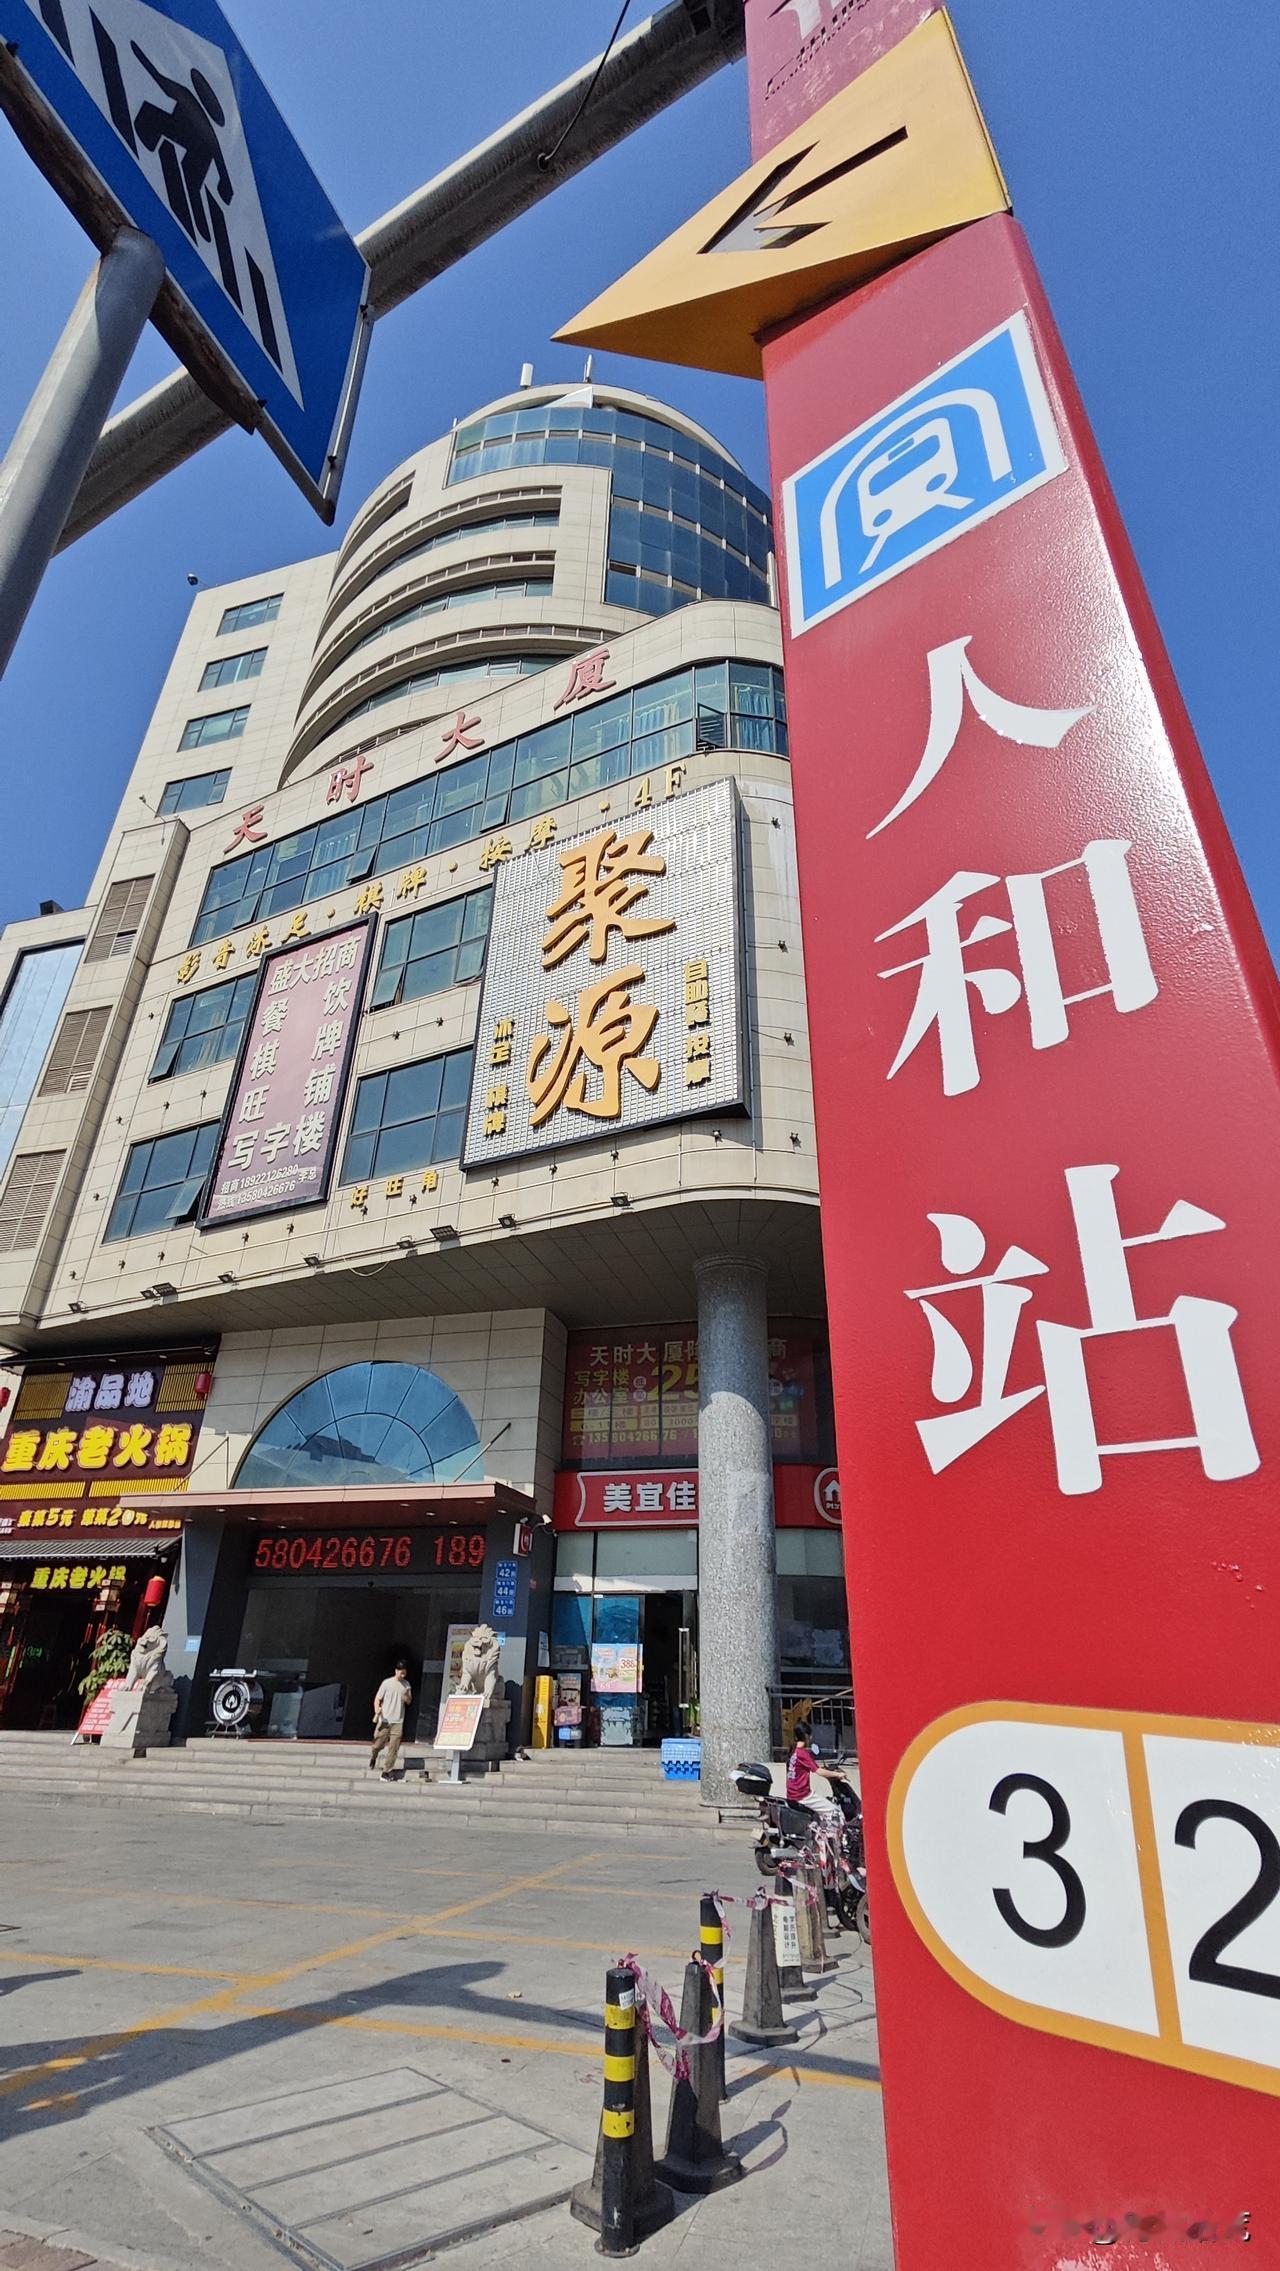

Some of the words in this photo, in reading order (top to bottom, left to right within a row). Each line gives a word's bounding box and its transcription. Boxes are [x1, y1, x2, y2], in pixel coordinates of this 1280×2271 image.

[224, 648, 617, 854] 天时大厦
[268, 934, 362, 997] 盛大招商
[527, 827, 678, 1129] 聚源
[260, 978, 353, 1038] 餐饮
[250, 1019, 344, 1082] 棋牌
[866, 635, 1261, 1496] 人和站
[239, 1065, 336, 1124] 旺铺
[227, 1111, 326, 1172] 写字楼
[352, 1169, 439, 1208] 好旺角
[575, 1368, 630, 1388] 写字楼
[1, 1423, 193, 1473] 重庆老火锅
[603, 1481, 696, 1513] 美宜佳
[31, 1566, 126, 1590] 重庆老火锅
[255, 1536, 412, 1569] 580426676
[434, 1534, 486, 1567] 189
[989, 1773, 1087, 1949] 3
[1174, 1799, 1280, 2001] 2
